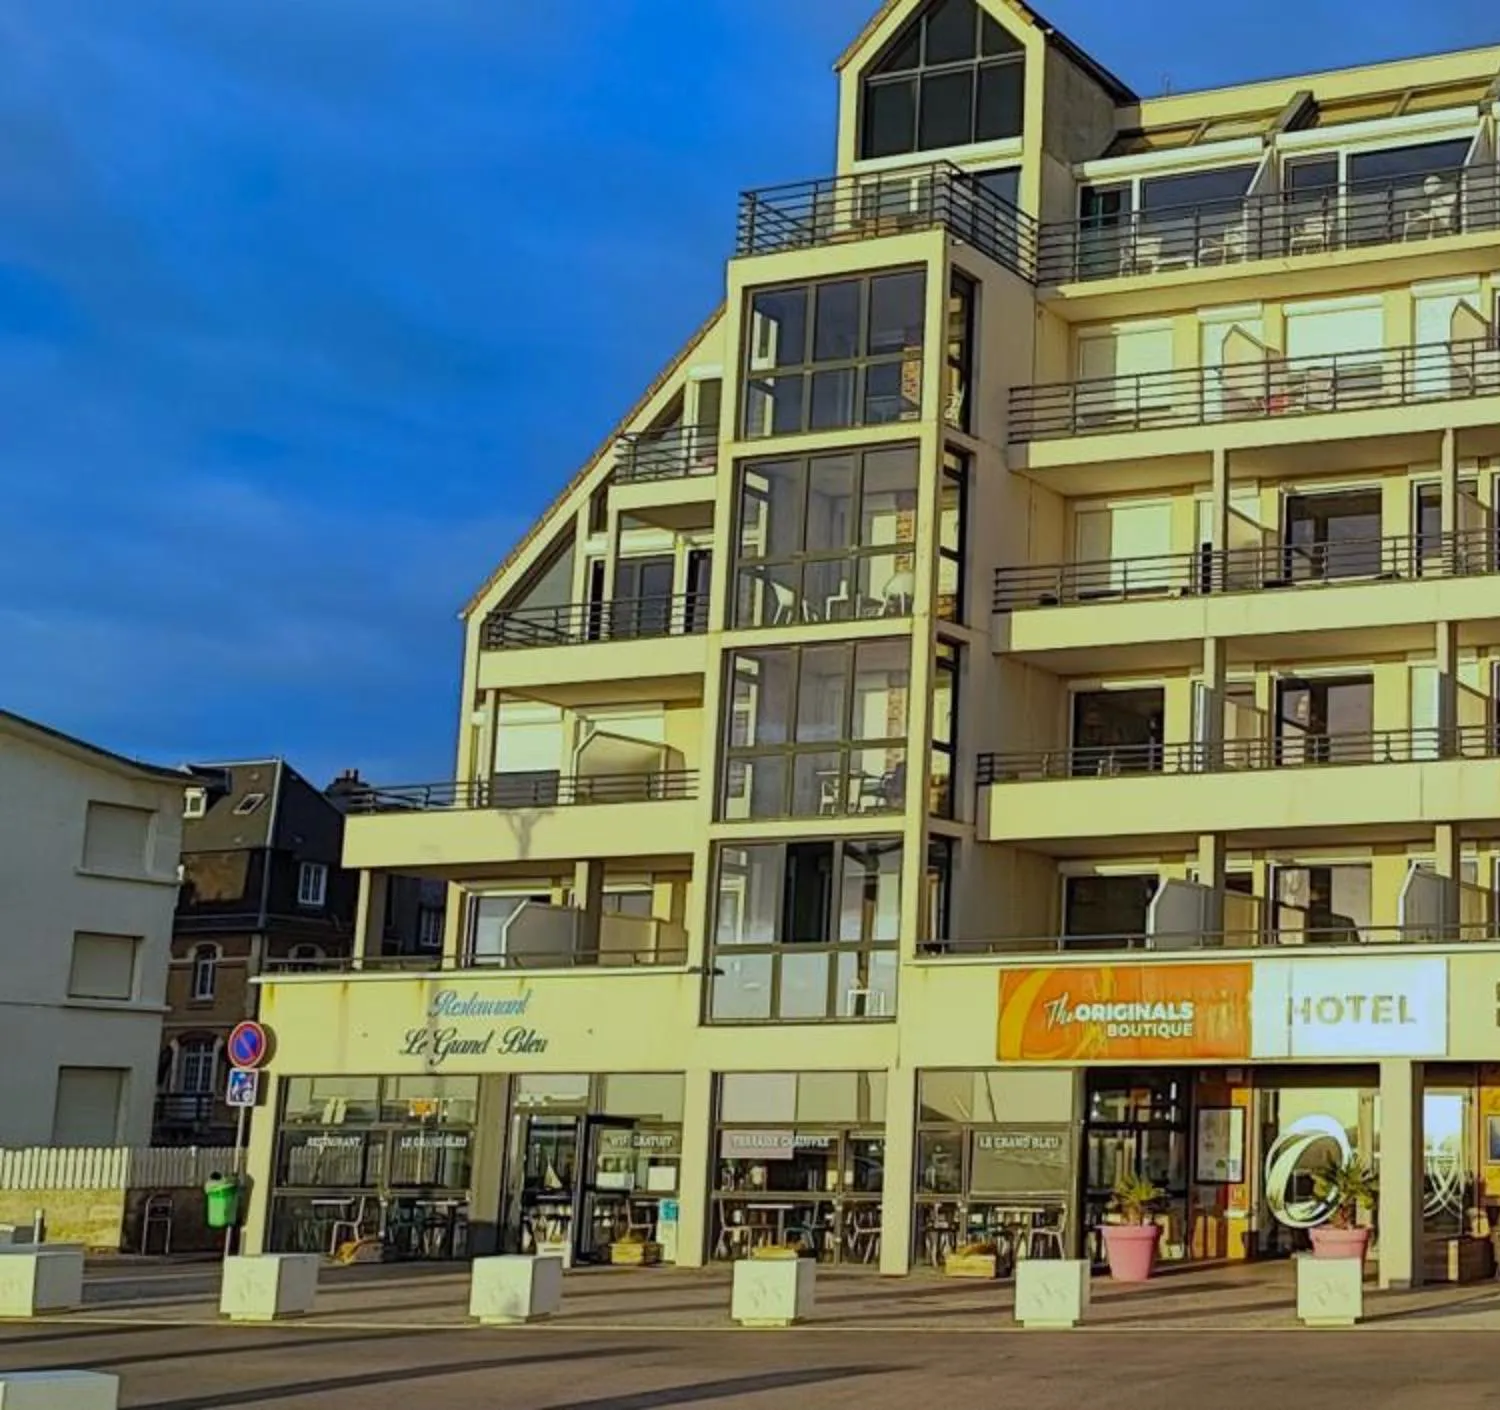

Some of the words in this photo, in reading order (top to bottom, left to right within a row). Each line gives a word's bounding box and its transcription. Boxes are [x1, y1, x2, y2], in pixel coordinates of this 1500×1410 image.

[428, 988, 532, 1017] Restaurant
[1043, 991, 1073, 1031] The
[1075, 1001, 1194, 1022] ORIGINALS
[1286, 994, 1418, 1026] HOTEL
[400, 1027, 429, 1055] Le
[428, 1026, 495, 1066] Grand
[497, 1025, 549, 1055] Bleu
[1107, 1023, 1194, 1039] BOUTIQUE
[400, 1135, 412, 1148] LE
[979, 1135, 992, 1149] LE
[993, 1135, 1031, 1149] GRAND
[1031, 1135, 1060, 1149] BLEU
